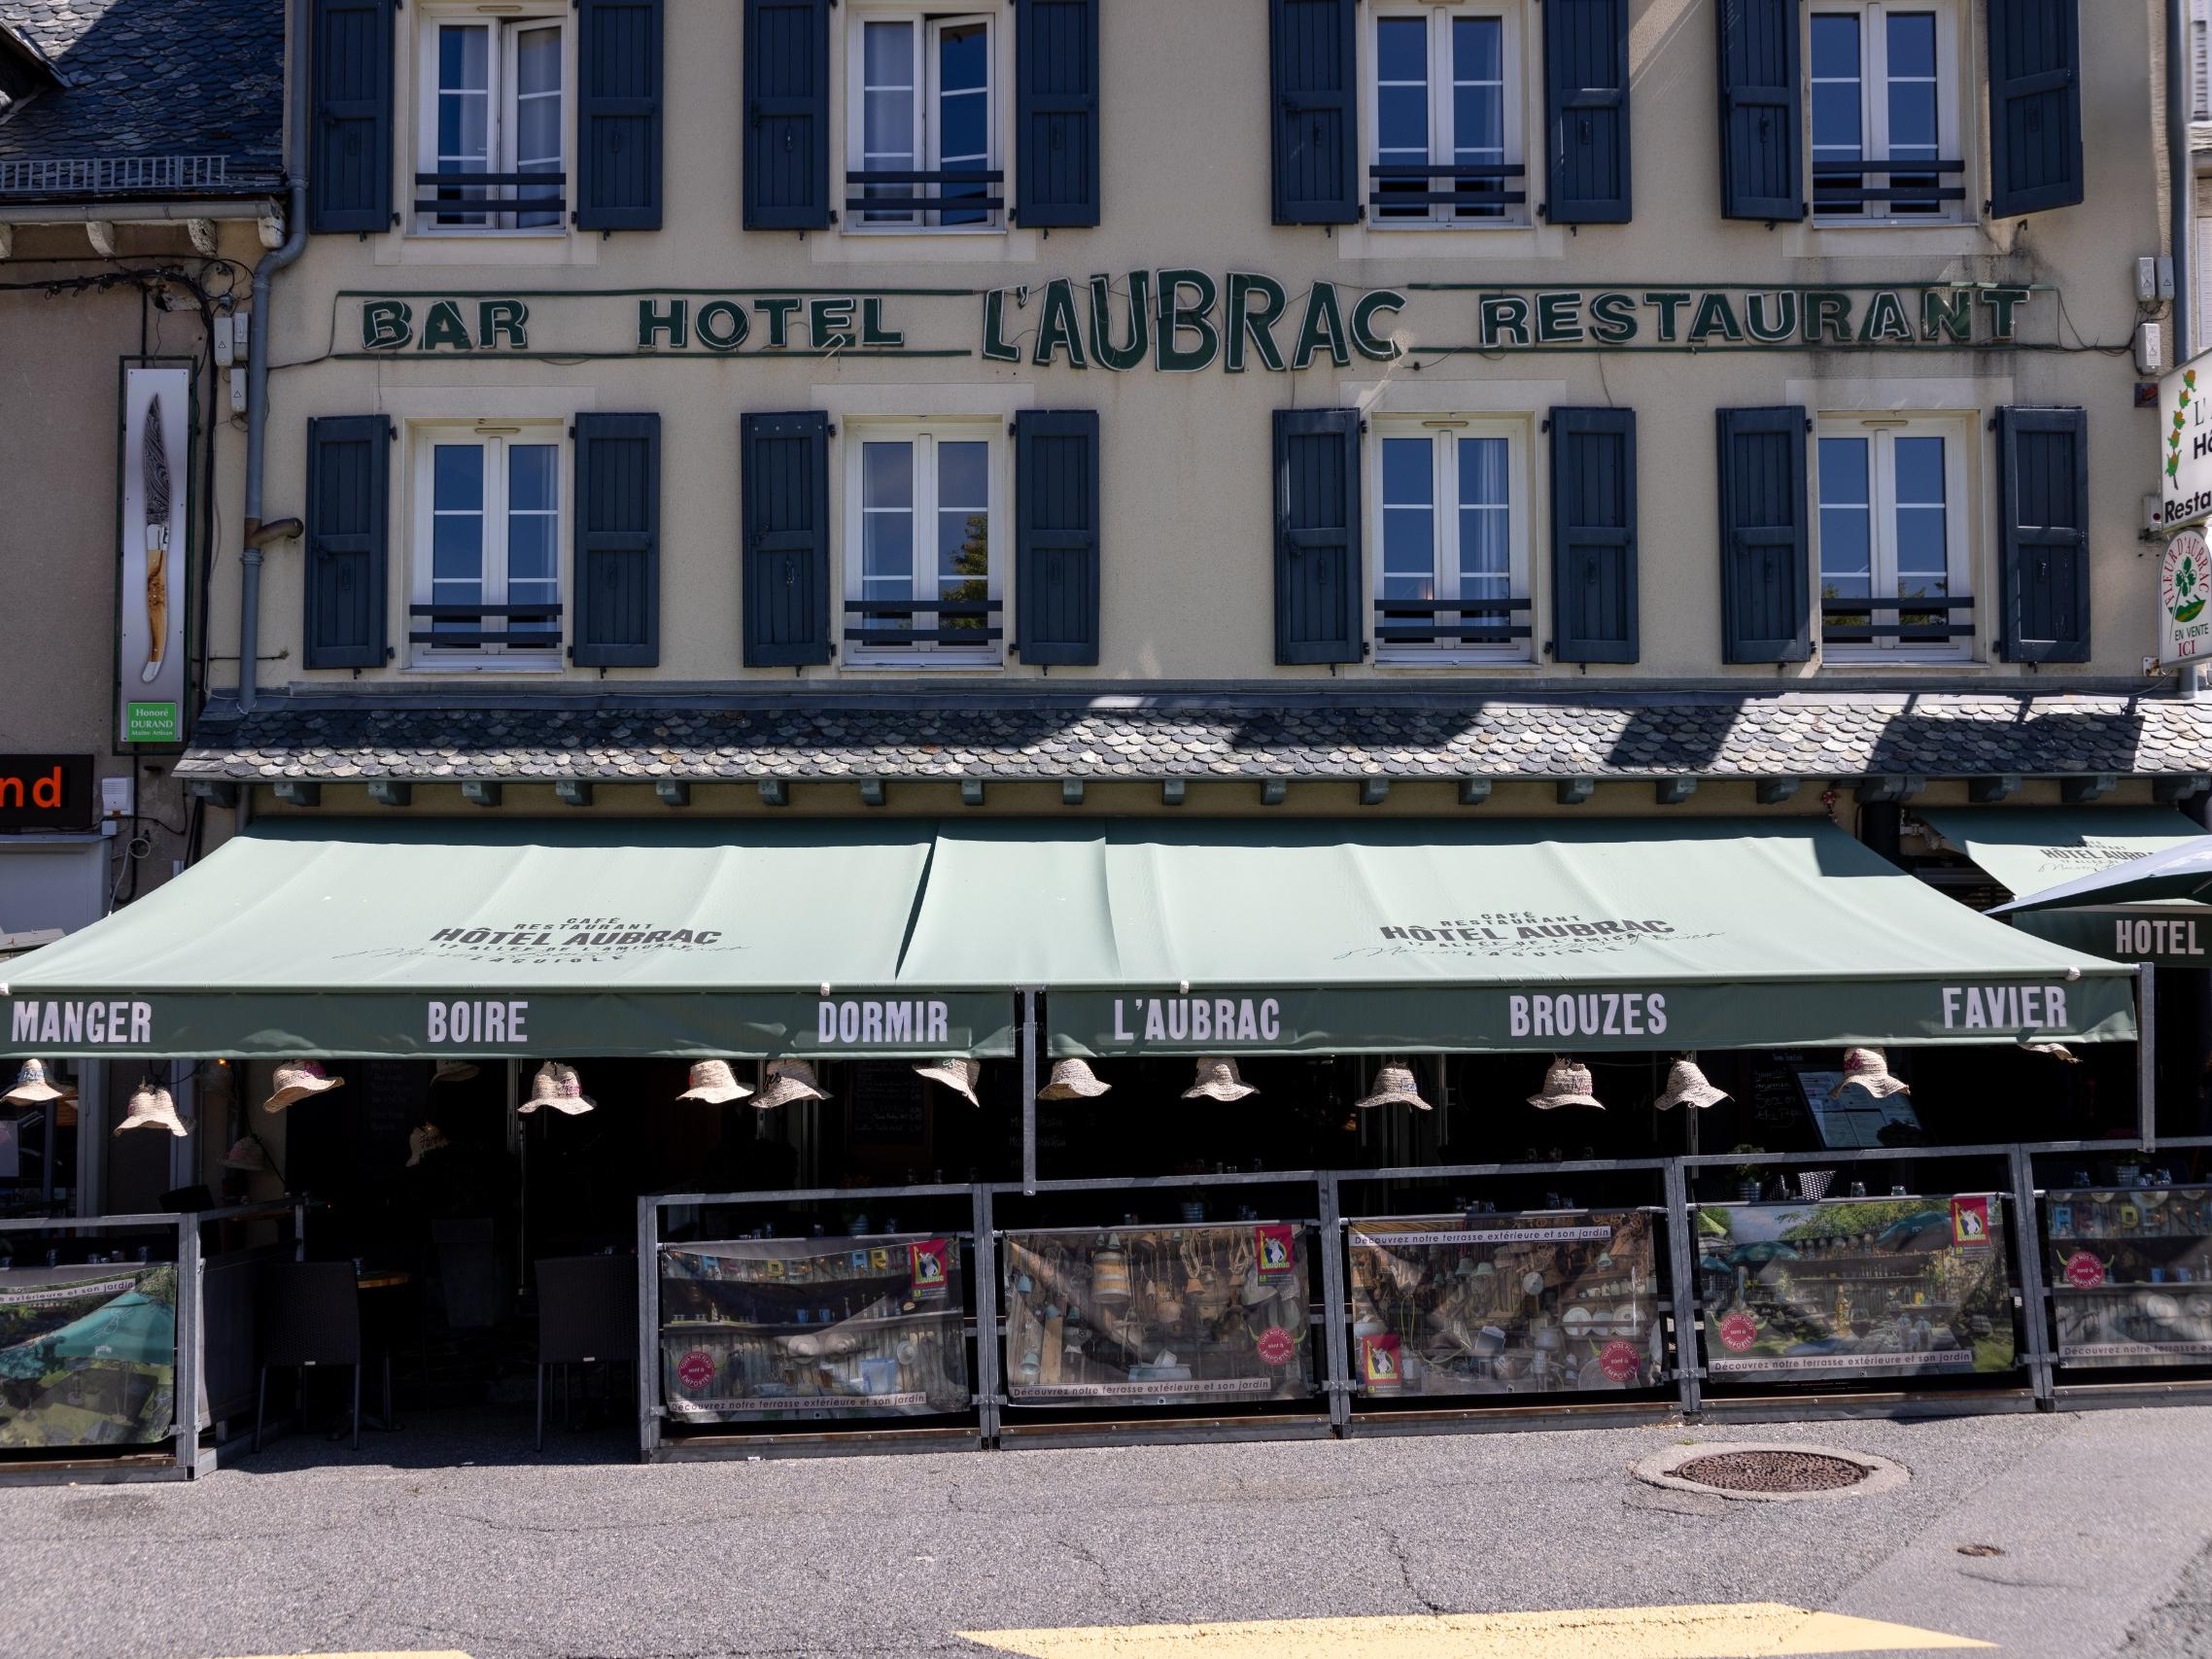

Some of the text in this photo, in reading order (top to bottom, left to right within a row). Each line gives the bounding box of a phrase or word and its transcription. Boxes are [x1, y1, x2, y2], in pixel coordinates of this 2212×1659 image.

[359, 297, 905, 352] BAR HOTEL
[982, 268, 1407, 373] L'AUBRAC
[1479, 290, 2030, 348] RESTAURANT
[2163, 549, 2178, 607] FLEUR
[2175, 623, 2209, 641] EN VENTE
[2178, 640, 2196, 658] ICI
[136, 708, 169, 717] Honoré
[1439, 916, 1580, 927] RESTAURANT
[1481, 911, 1536, 920] CAFÉ
[429, 927, 722, 946] HÔTEL AUBRAC
[1379, 919, 1676, 941] HÔTEL AUBRAC
[2116, 919, 2205, 954] HOTEL
[1509, 992, 1668, 1037] BROUZES
[1942, 985, 2068, 1029] FAVIER
[11, 1000, 152, 1044] MANGER
[427, 1000, 529, 1043] BOIRE
[817, 999, 949, 1044] DORMIR
[1114, 998, 1280, 1041] L'AUBRAC
[1413, 1233, 1437, 1243] notre
[1442, 1231, 1483, 1242] terrasse
[1487, 1229, 1539, 1240] extérieure
[1544, 1229, 1554, 1238] et
[1557, 1229, 1574, 1238] son
[1578, 1227, 1609, 1239] jardin
[82, 1286, 100, 1295] son
[2064, 1345, 2120, 1356] Découvrez
[2124, 1344, 2151, 1354] notre
[1714, 1361, 1769, 1371] Découvrez
[1772, 1359, 1799, 1368] notre
[1803, 1358, 1844, 1367] terrasse
[1905, 1355, 1915, 1364] et
[1918, 1355, 1936, 1364] son
[1939, 1352, 1970, 1364] jardin
[1014, 1387, 1069, 1398] Découvrez
[1218, 1382, 1235, 1391] son
[1239, 1379, 1269, 1391] jardin
[729, 1400, 755, 1409] notre
[759, 1399, 800, 1408] terrasse
[874, 1397, 891, 1406] son
[894, 1393, 926, 1405] jardin
